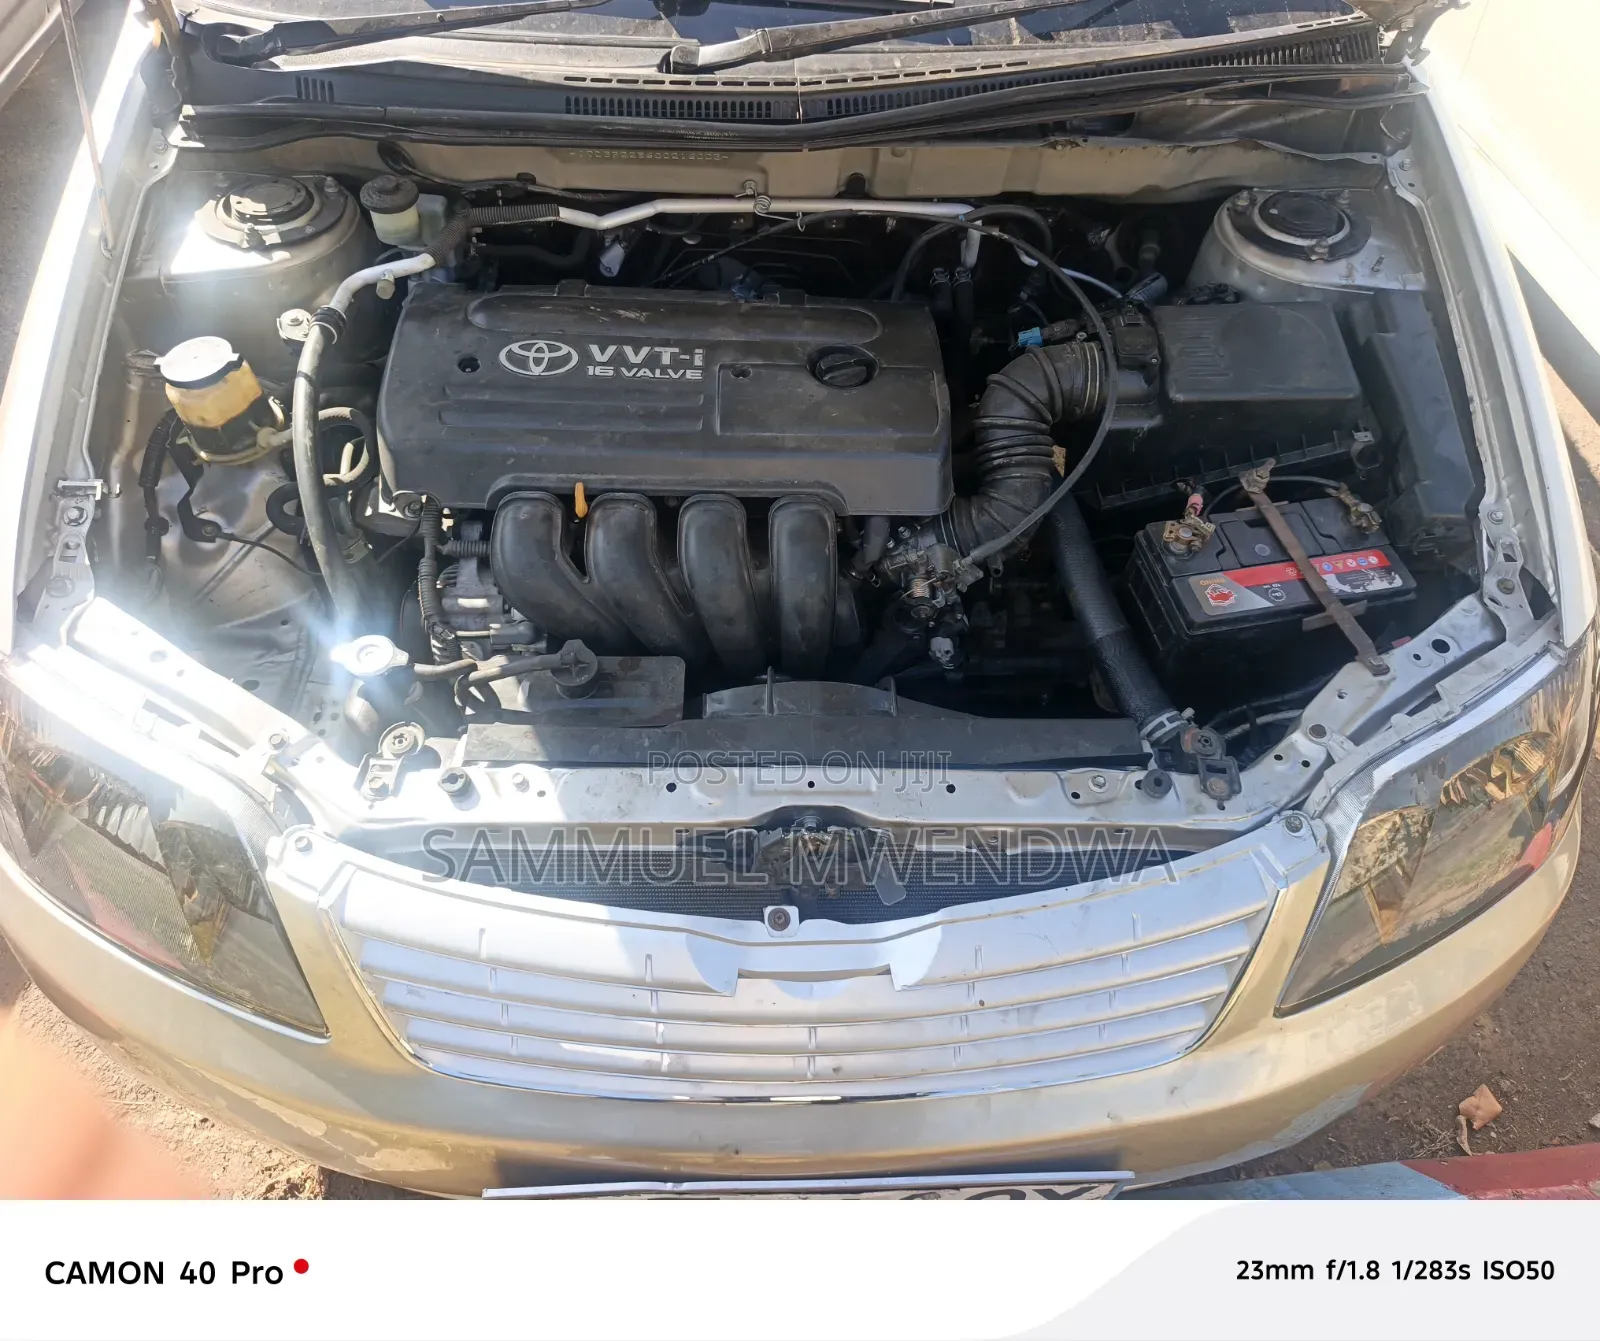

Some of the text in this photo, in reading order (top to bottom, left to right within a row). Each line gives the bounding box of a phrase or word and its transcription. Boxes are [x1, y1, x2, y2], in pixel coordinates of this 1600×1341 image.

[588, 343, 706, 368] VVT-i
[586, 365, 704, 380] 16 VALVE
